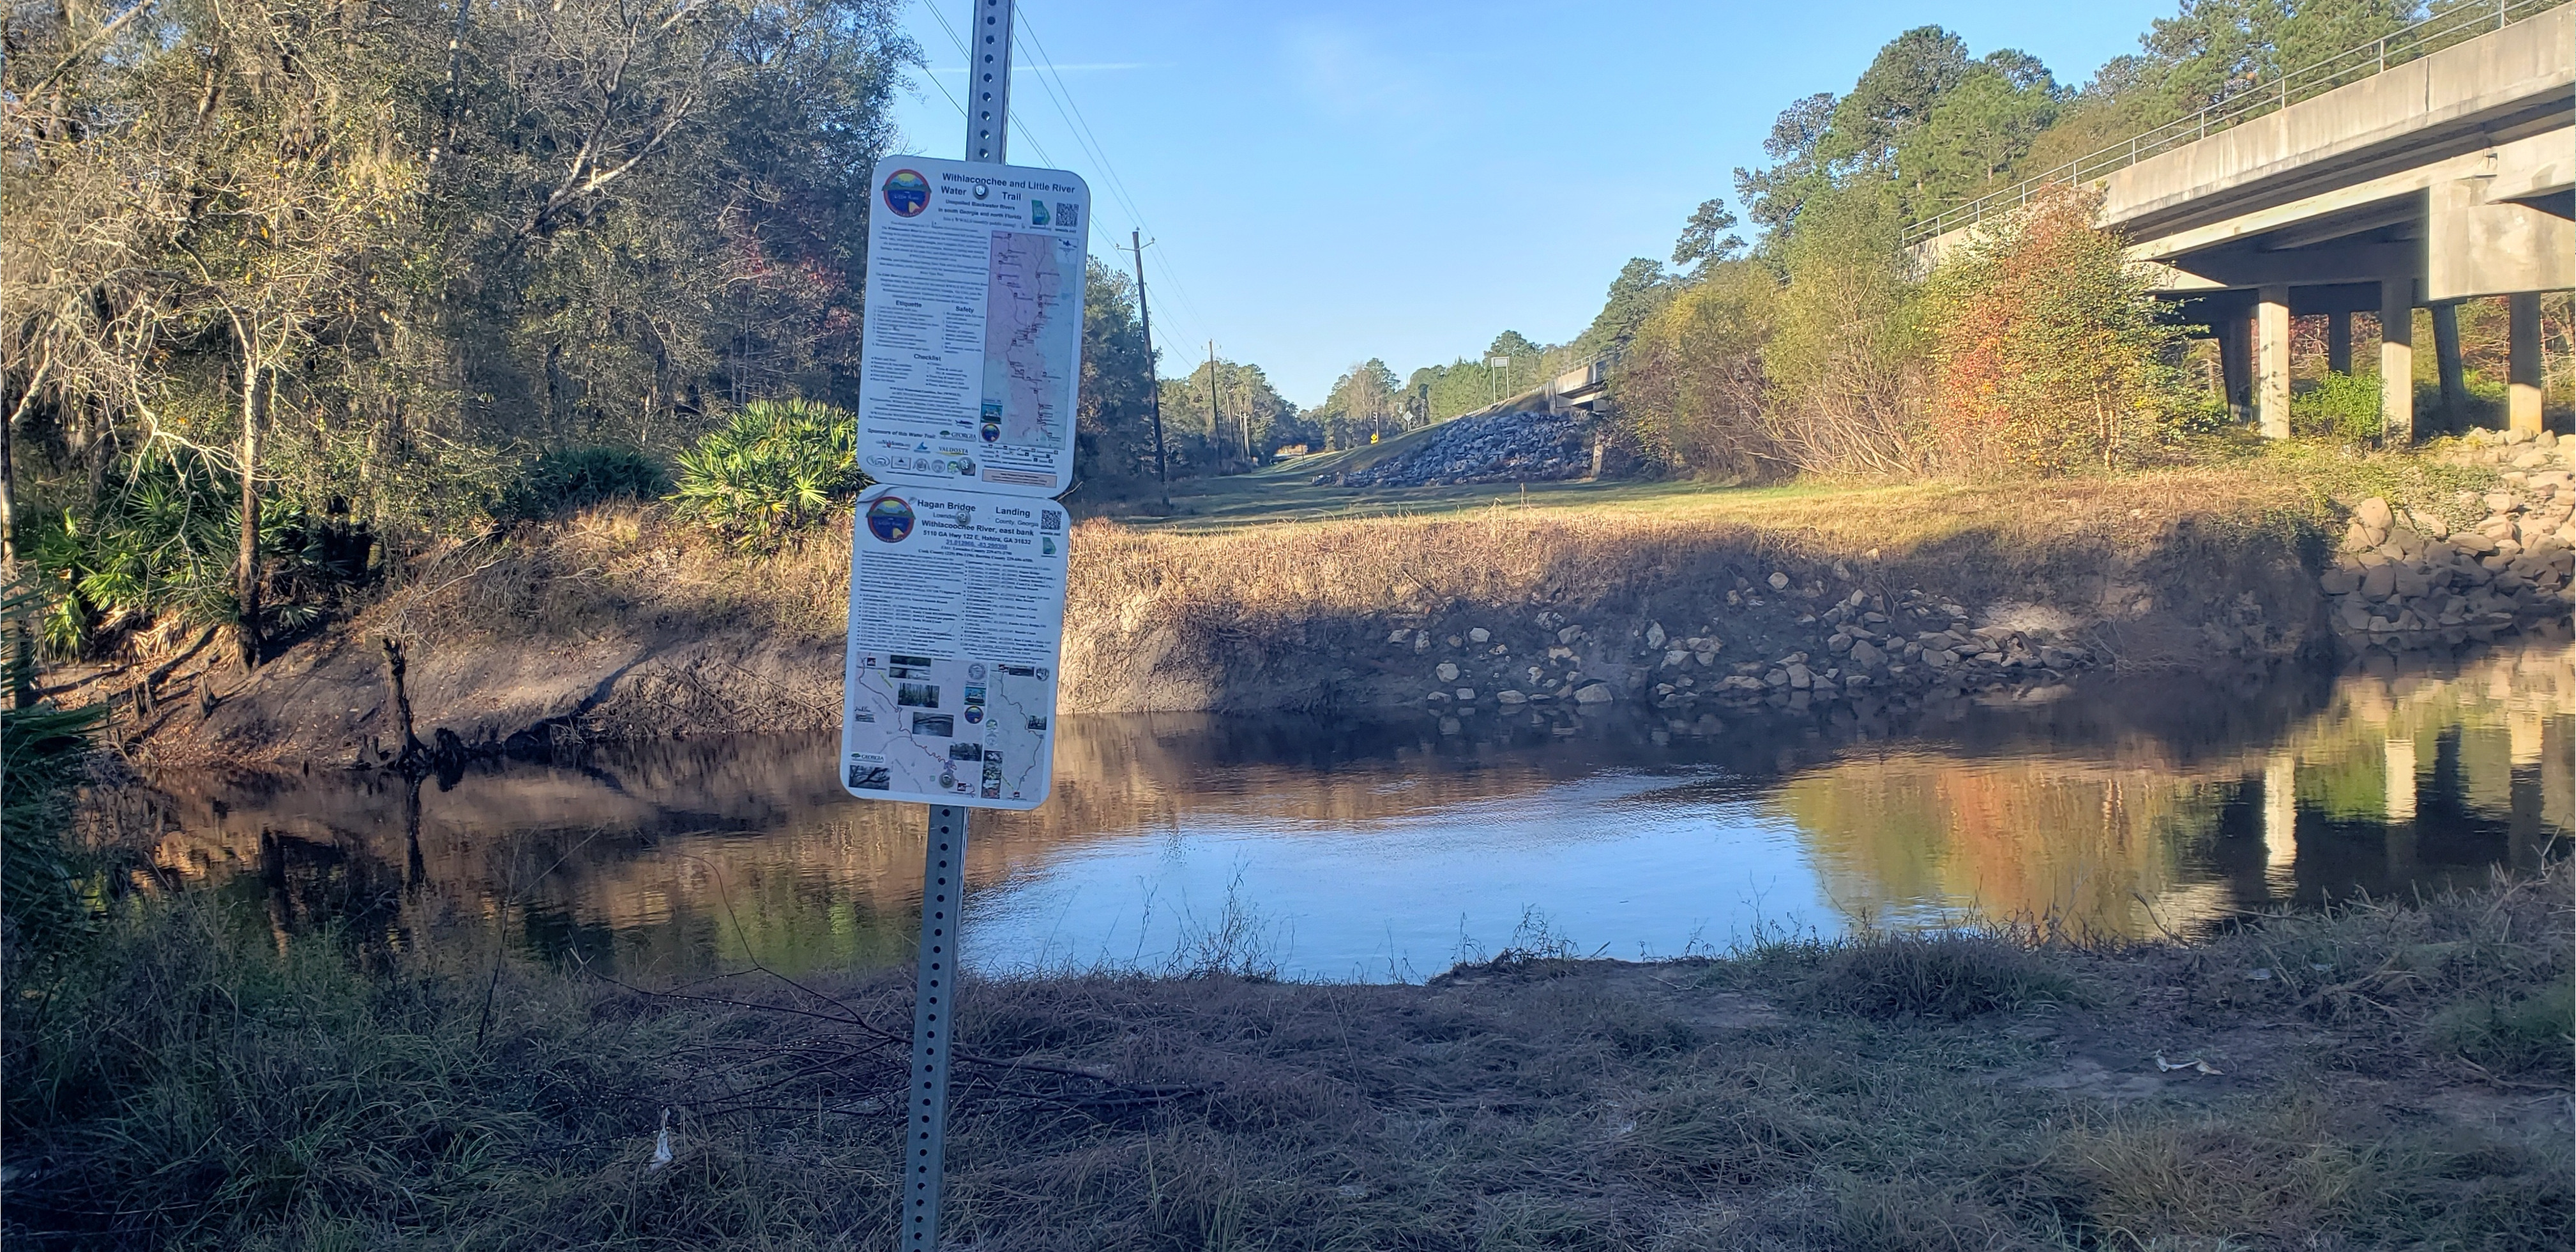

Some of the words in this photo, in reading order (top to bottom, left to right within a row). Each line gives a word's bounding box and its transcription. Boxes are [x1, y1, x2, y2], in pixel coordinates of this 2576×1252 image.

[943, 172, 1007, 187] Withlacoochee
[1010, 180, 1026, 189] and
[1029, 182, 1050, 191] Little
[1052, 183, 1075, 194] River
[941, 186, 967, 195] Water
[1002, 192, 1021, 201] Trail
[955, 305, 974, 314] Safety
[914, 353, 941, 362] Checklist
[918, 500, 944, 510] Hagan
[948, 502, 976, 512] Bridge
[996, 507, 1031, 519] Landing
[921, 520, 974, 531] Withlacoochee
[976, 525, 997, 534] River,
[1017, 520, 1039, 528] Georgia
